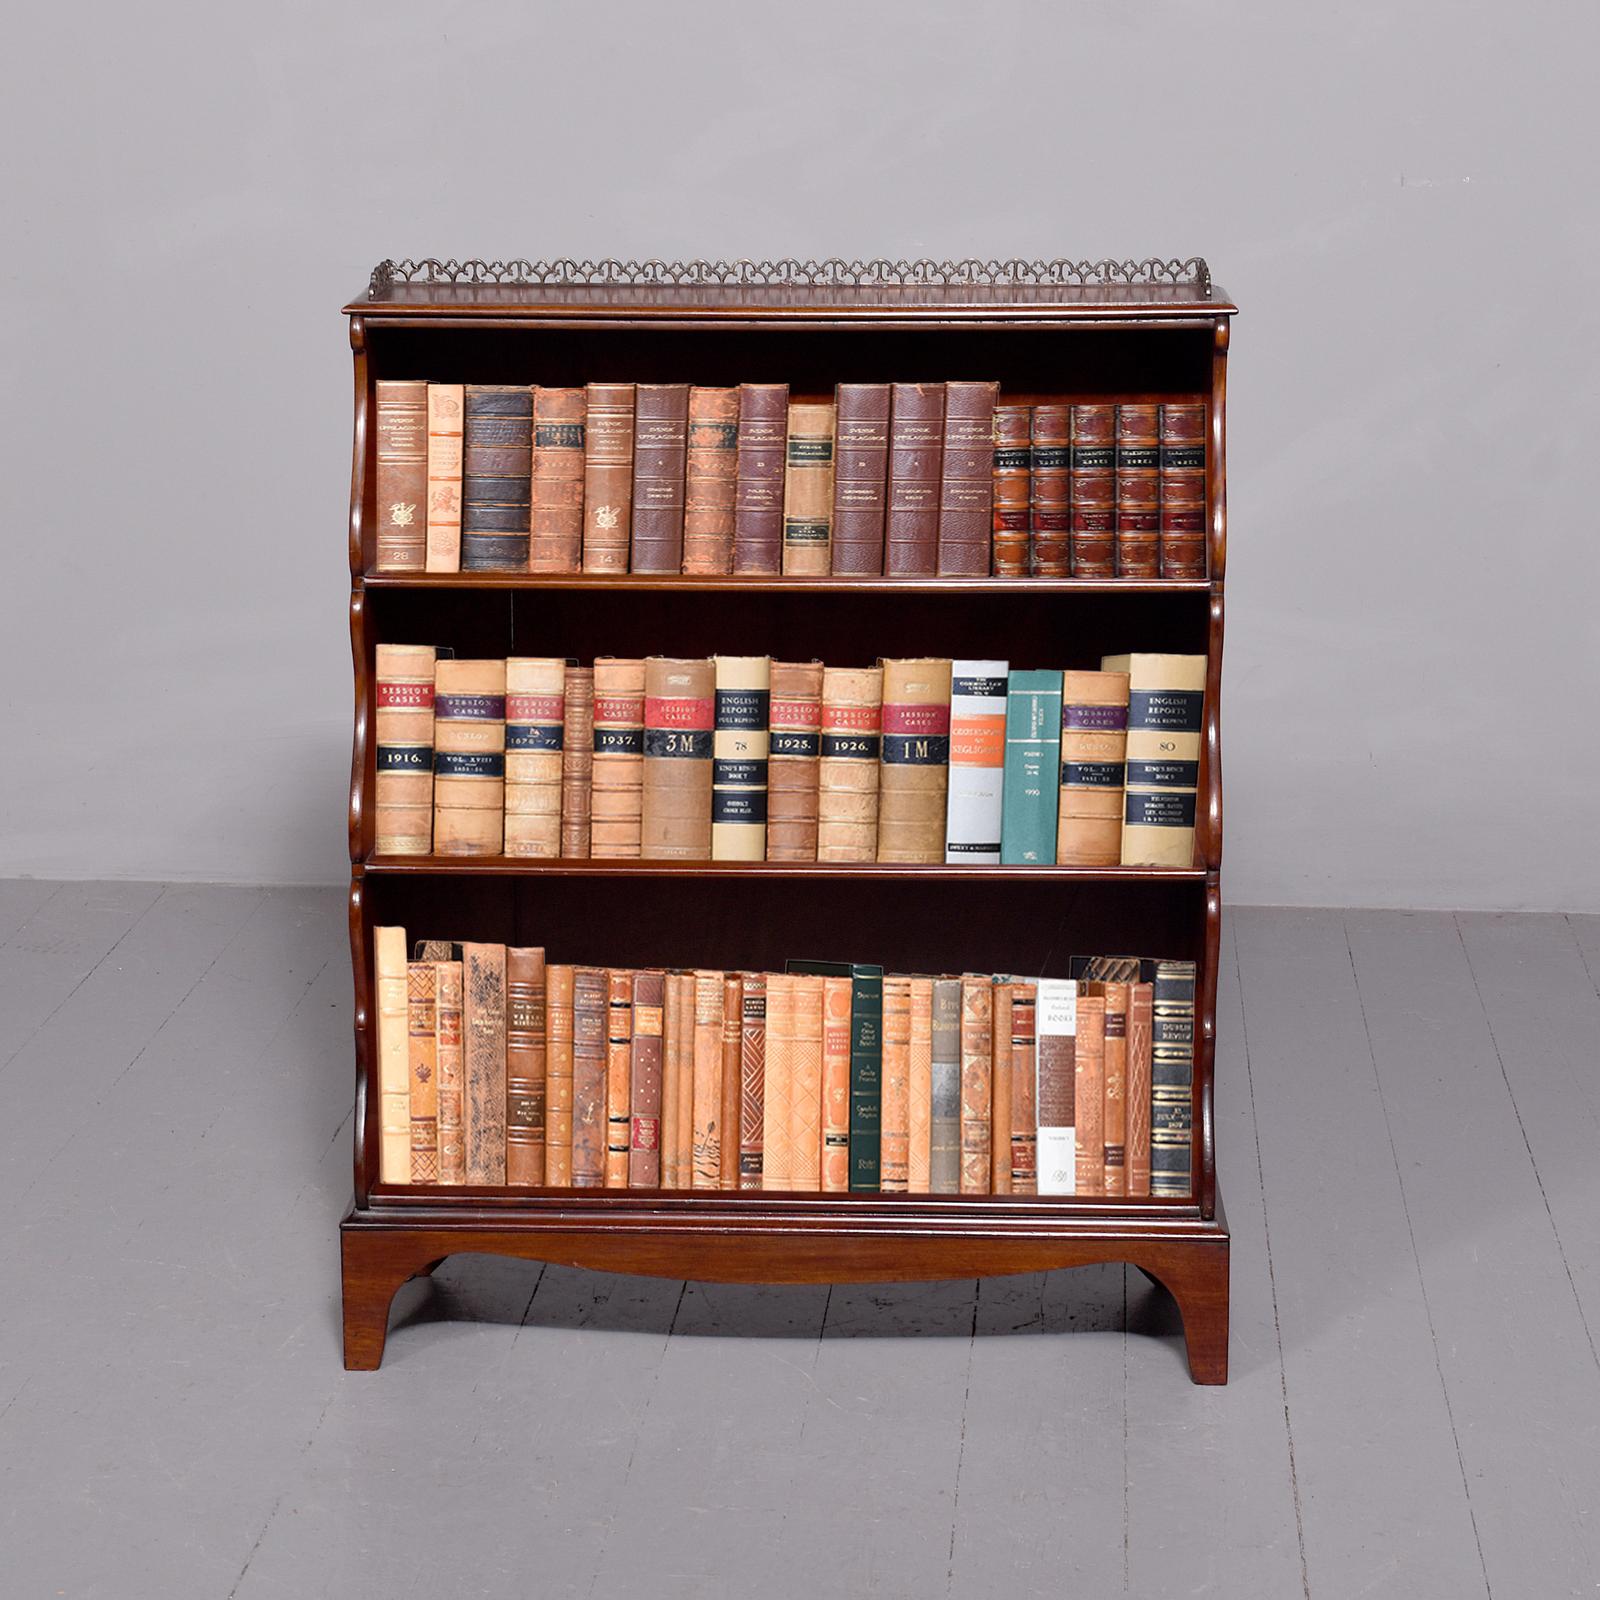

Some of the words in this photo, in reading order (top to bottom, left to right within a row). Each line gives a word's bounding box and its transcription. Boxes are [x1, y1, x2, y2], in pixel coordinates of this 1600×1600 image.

[393, 552, 409, 560] 28
[382, 687, 429, 695] SESSION
[721, 697, 759, 705] ENGLISH
[1149, 697, 1187, 705] ENGLISH
[597, 702, 640, 710] SESSION
[721, 706, 759, 714] REPORTS
[1148, 707, 1186, 715] REPORTS
[602, 736, 635, 745] 1937.
[666, 734, 677, 752] 3
[778, 739, 812, 749] 1925.
[835, 742, 869, 751] 1926.
[387, 754, 422, 763] 1916.
